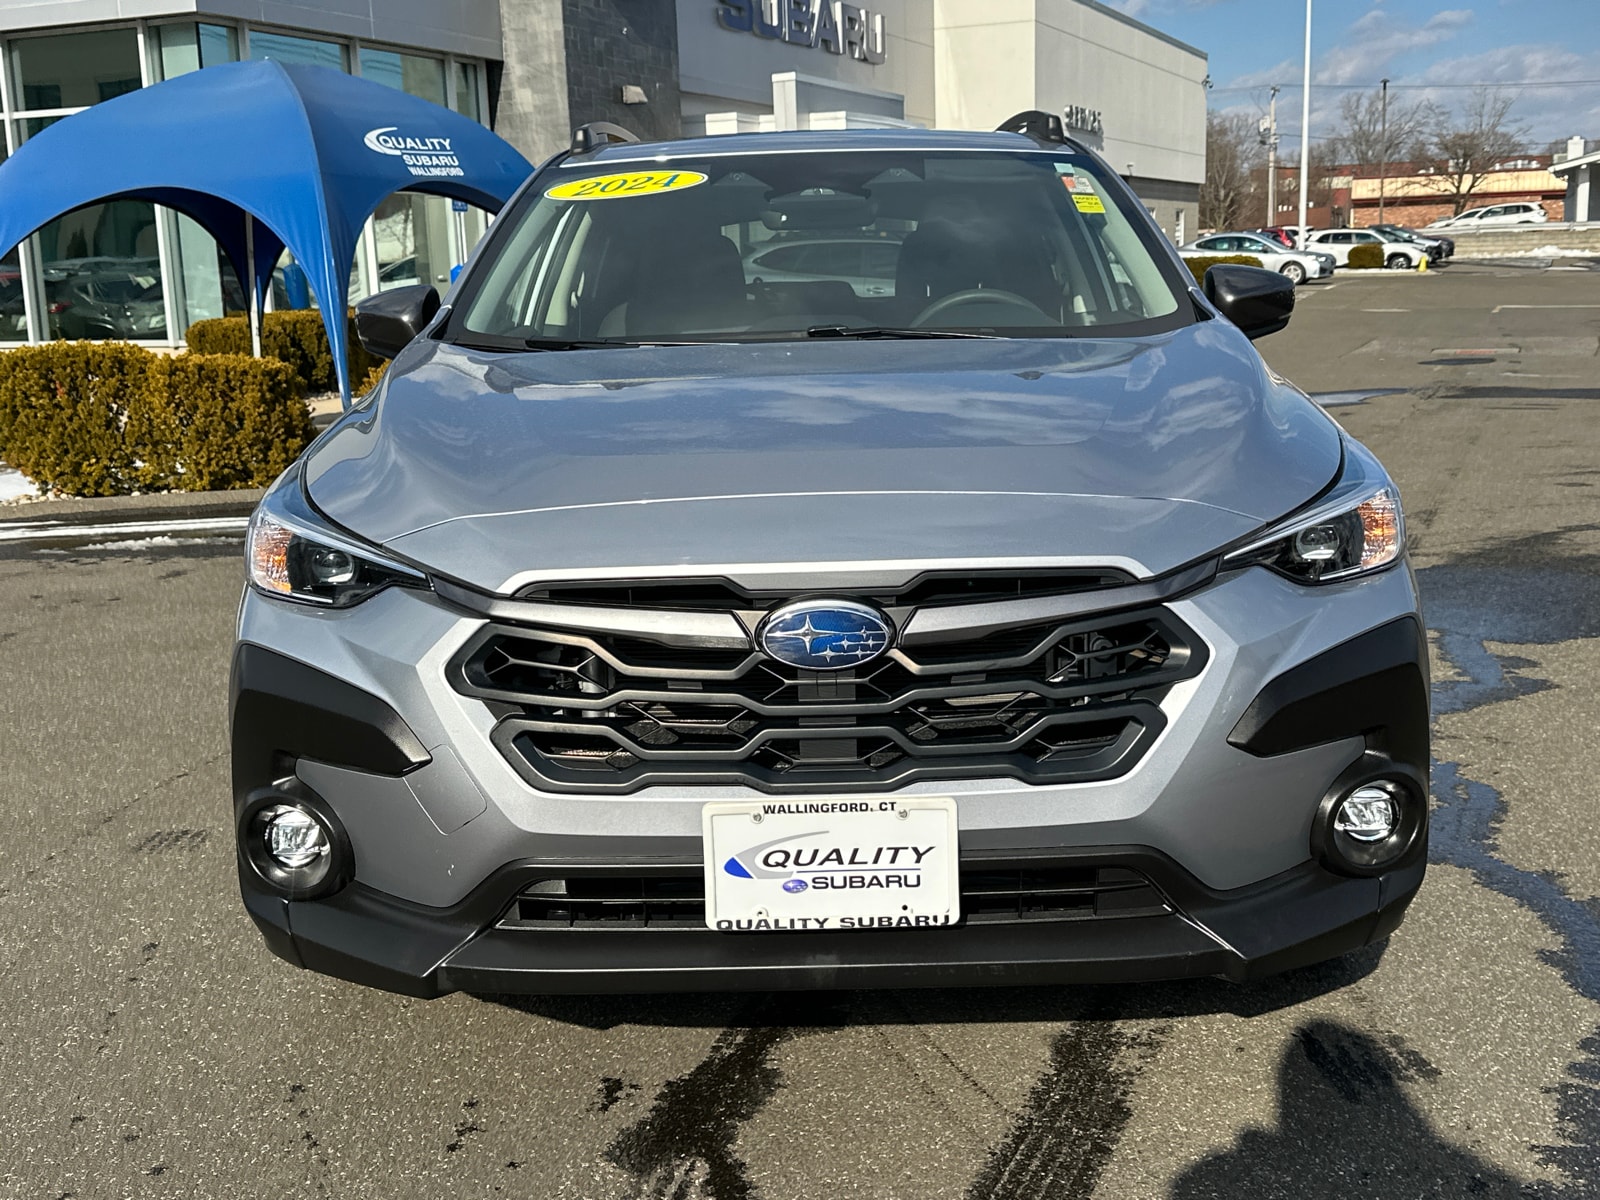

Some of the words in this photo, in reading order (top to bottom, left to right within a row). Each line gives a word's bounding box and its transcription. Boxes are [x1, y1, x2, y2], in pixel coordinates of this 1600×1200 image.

[717, 0, 887, 64] SUBARU
[378, 135, 451, 150] QUALITY
[402, 154, 459, 166] SUBARU
[407, 166, 464, 177] WALLINGFORD
[572, 173, 681, 197] 2024
[879, 802, 897, 812] CT
[762, 846, 936, 869] QUALITY
[812, 875, 921, 889] SUBARU
[716, 918, 829, 930] QUALITY
[840, 915, 950, 928] SUBARU
